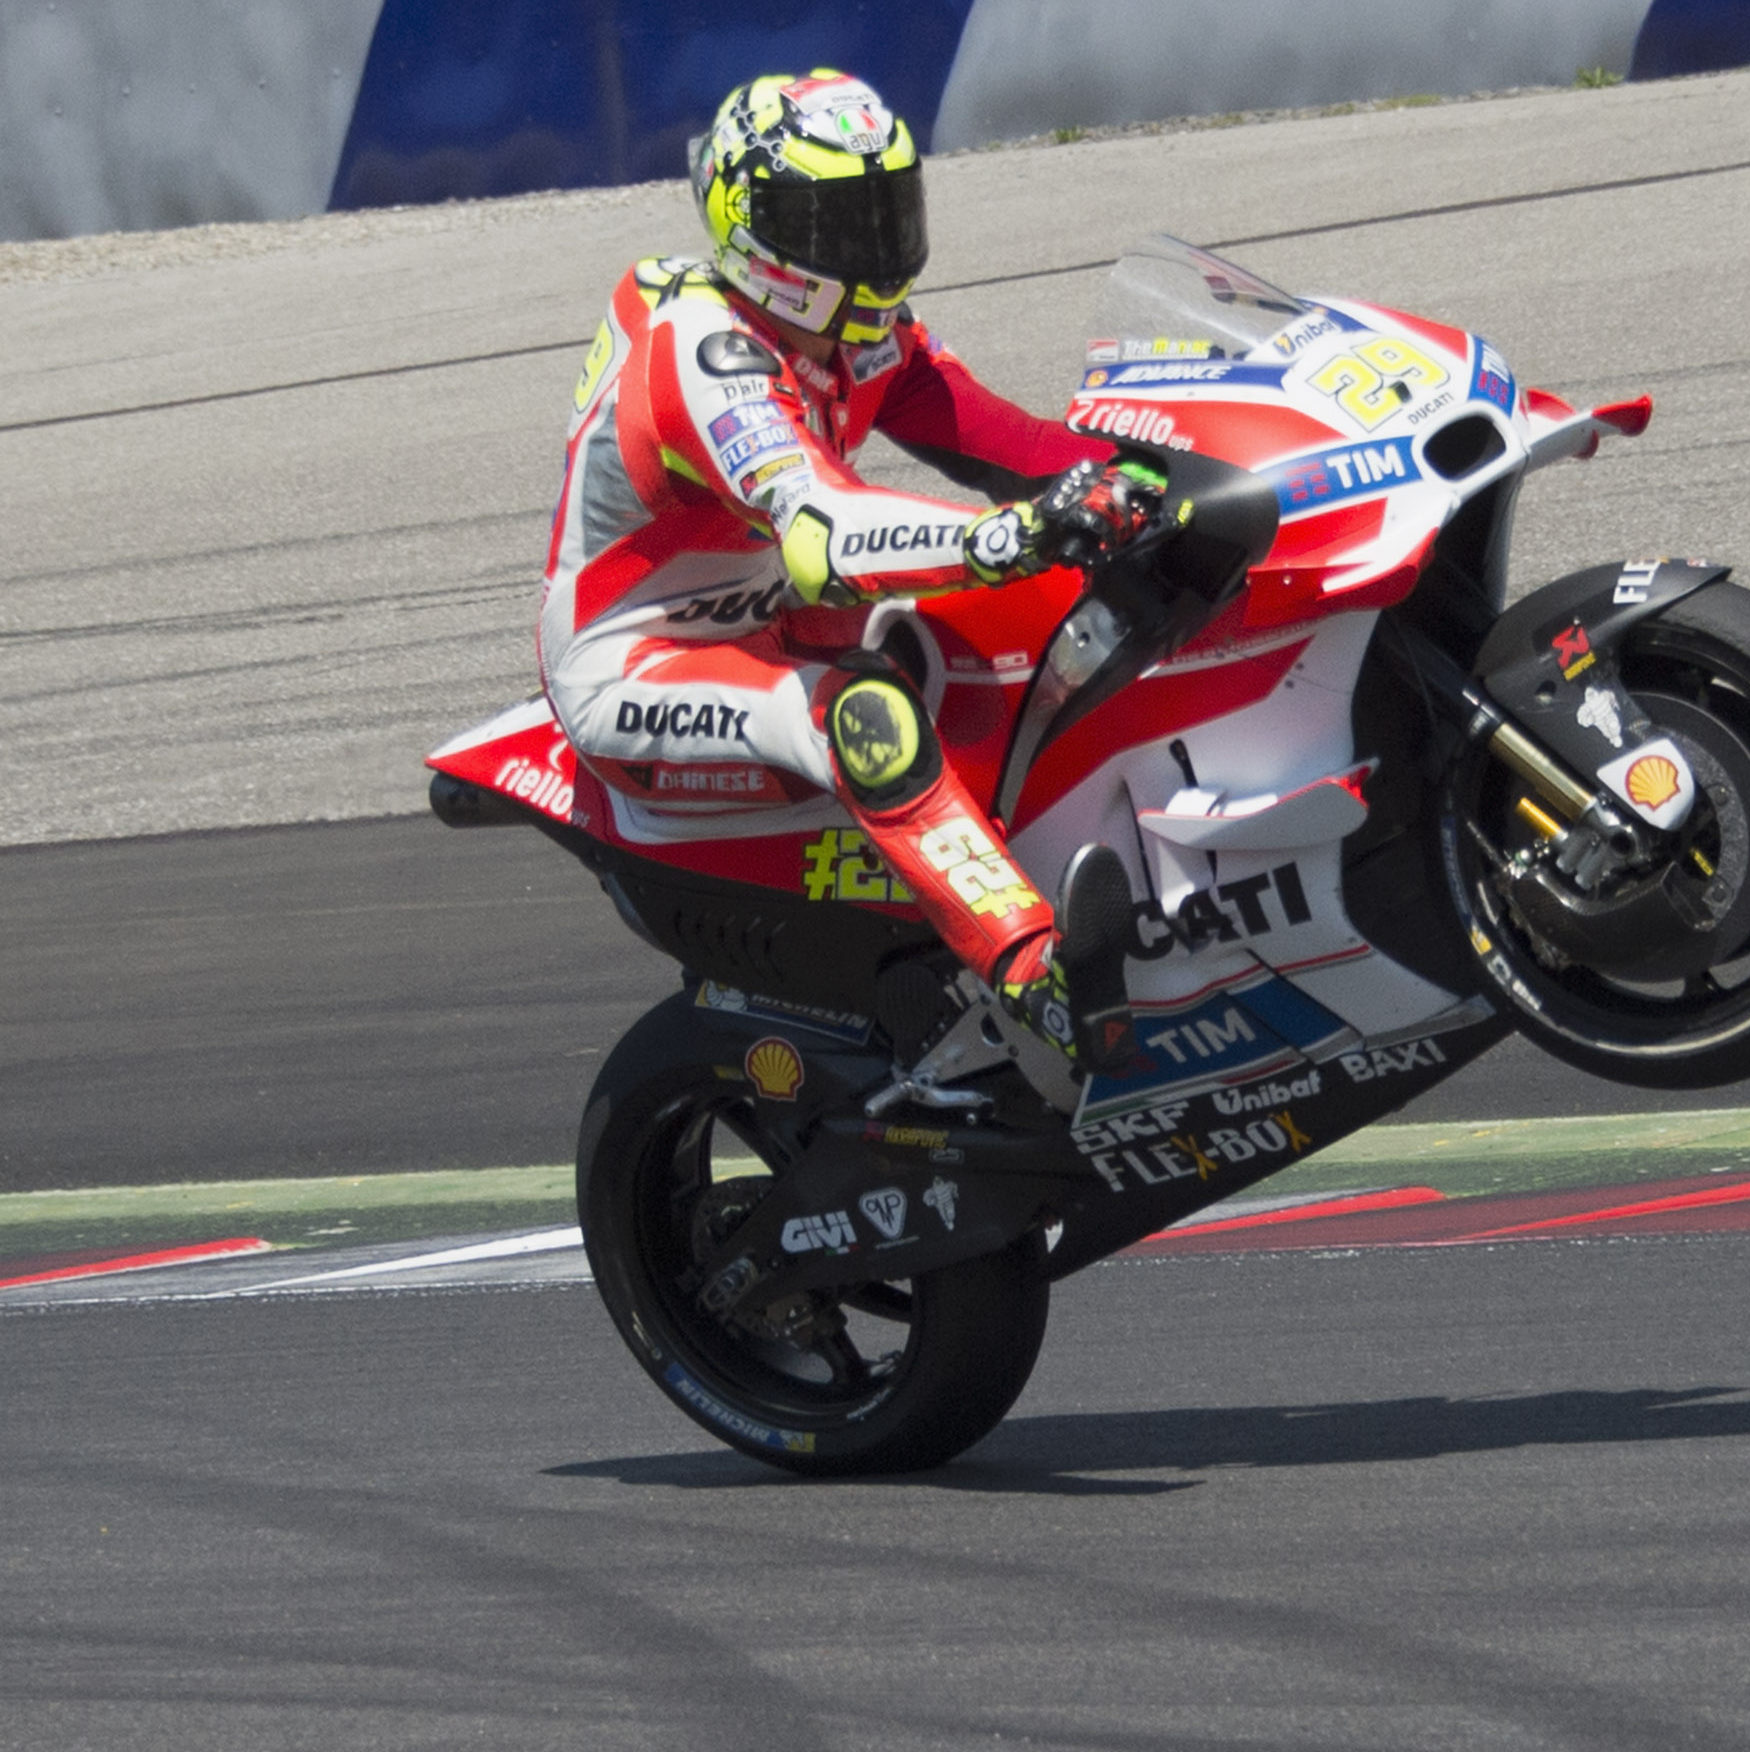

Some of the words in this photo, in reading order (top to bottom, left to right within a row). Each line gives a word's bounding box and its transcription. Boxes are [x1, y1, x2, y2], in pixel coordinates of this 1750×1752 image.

[1110, 364, 1232, 385] ADVANCE
[1306, 336, 1450, 434] 29
[731, 402, 785, 428] TIM
[1088, 402, 1174, 445] riello
[1407, 391, 1455, 426] DUCATI
[1325, 444, 1406, 489] TIM
[840, 524, 967, 558] DUCATI
[616, 701, 750, 741] DUCATI
[494, 756, 574, 815] riello
[804, 828, 915, 902] #2
[1128, 861, 1312, 961] CATI
[1146, 1007, 1256, 1064] TIM
[1340, 1037, 1447, 1083] BAXI
[1212, 1070, 1321, 1116] Unibat
[1070, 1100, 1190, 1154] SKF
[1091, 1110, 1312, 1193] FLEX-BOX
[781, 1210, 858, 1254] GIVI
